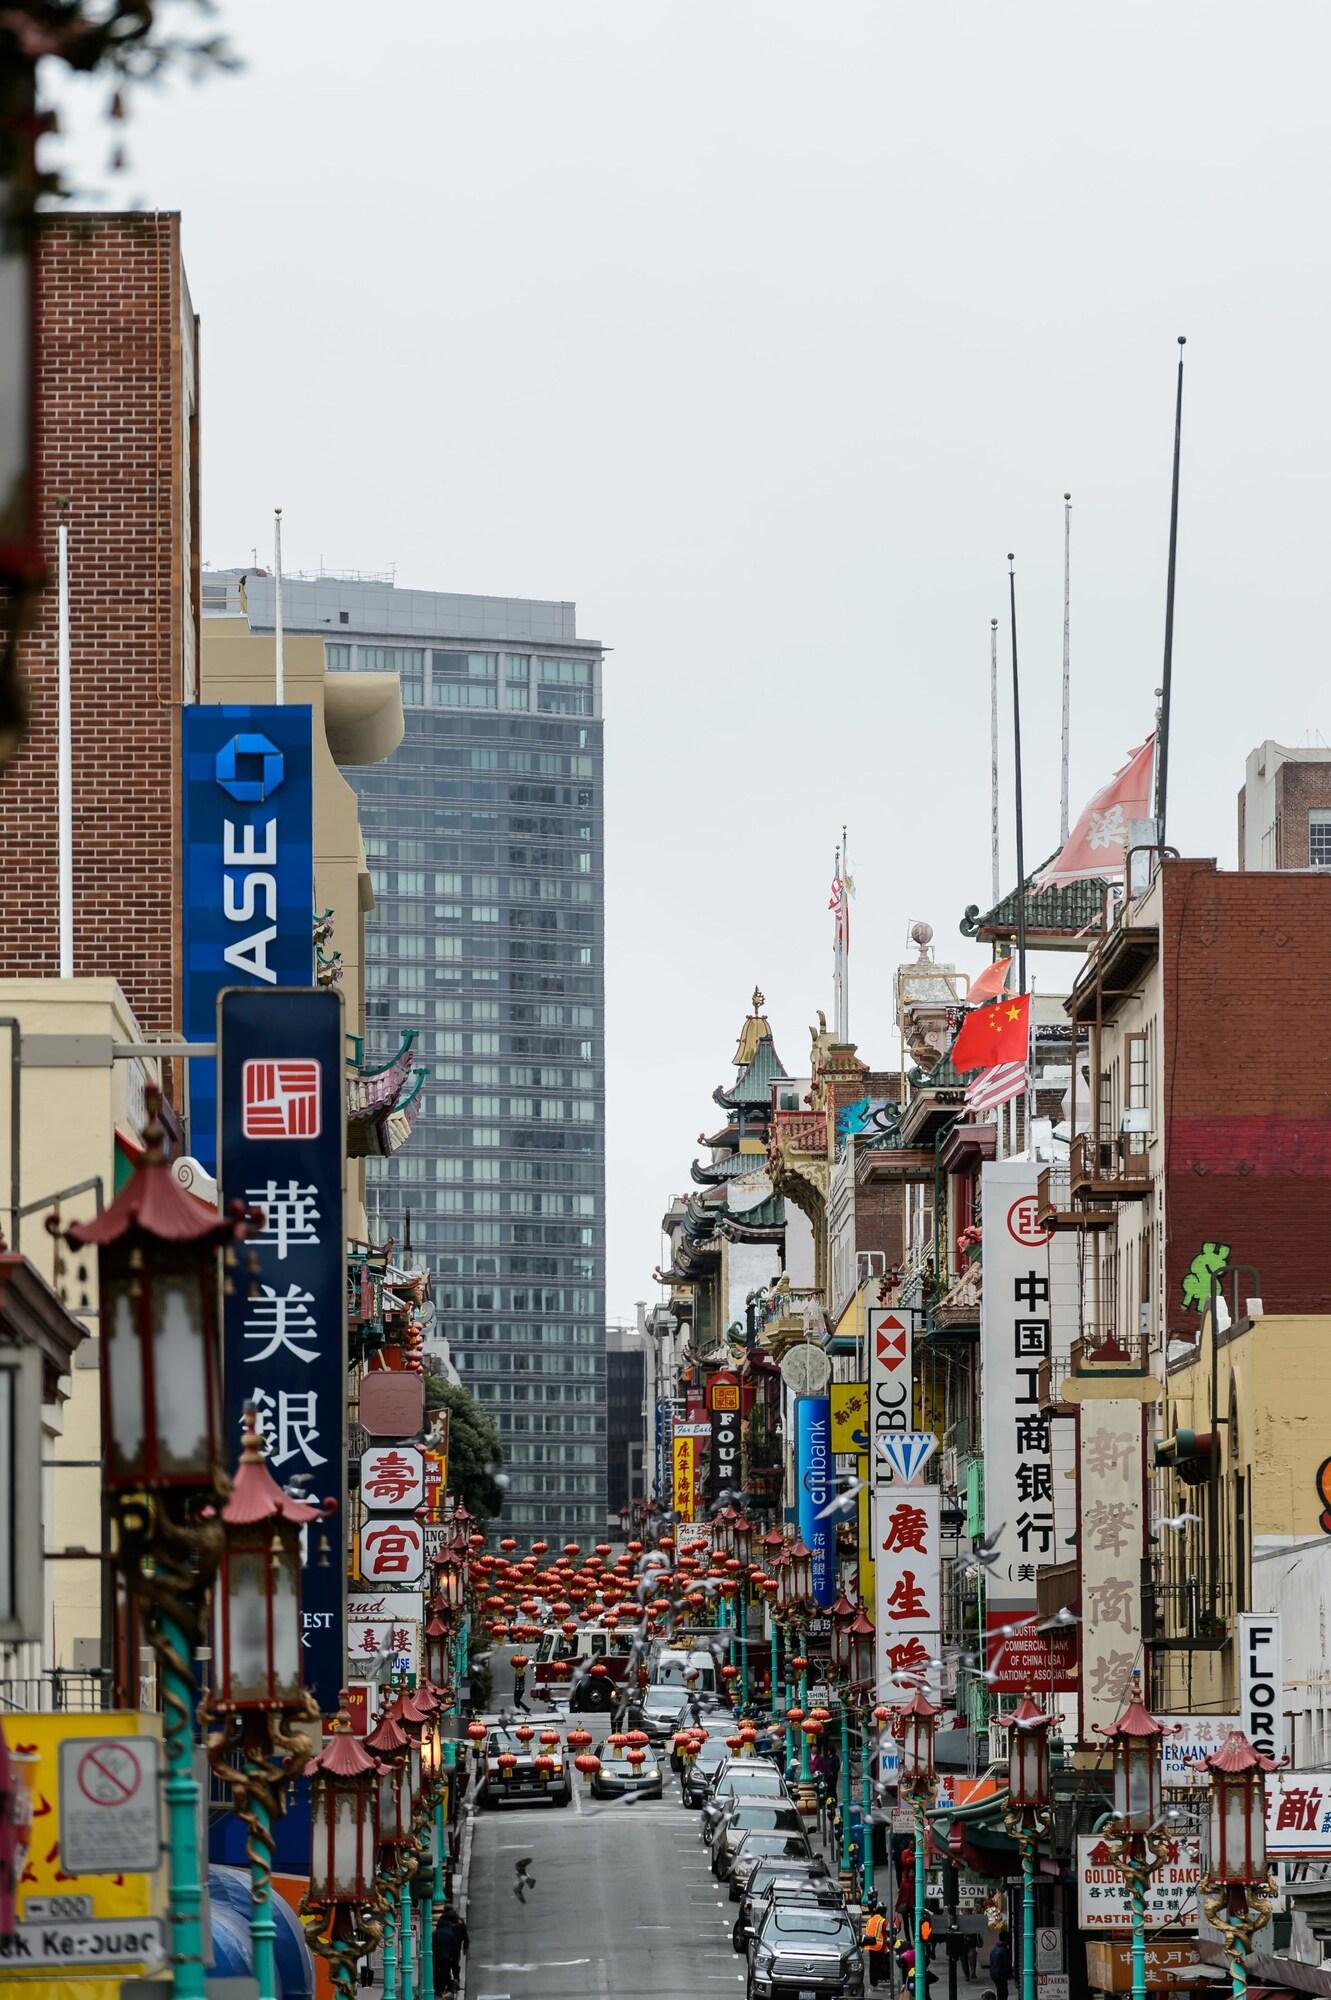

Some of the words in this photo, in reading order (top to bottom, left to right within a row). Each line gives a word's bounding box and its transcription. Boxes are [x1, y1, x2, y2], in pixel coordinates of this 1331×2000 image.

[1014, 1270, 1054, 1553] 中国工商银行
[875, 1381, 908, 1485] BC
[717, 1412, 735, 1478] FOUR
[806, 1419, 826, 1505] citibank
[301, 1612, 334, 1629] EST
[1004, 1640, 1049, 1652] COMMERCIAL
[1010, 1655, 1019, 1667] OF
[999, 1669, 1030, 1681] NATIONA
[928, 1887, 985, 1896] JASON
[1086, 1914, 1153, 1924] PASTRS
